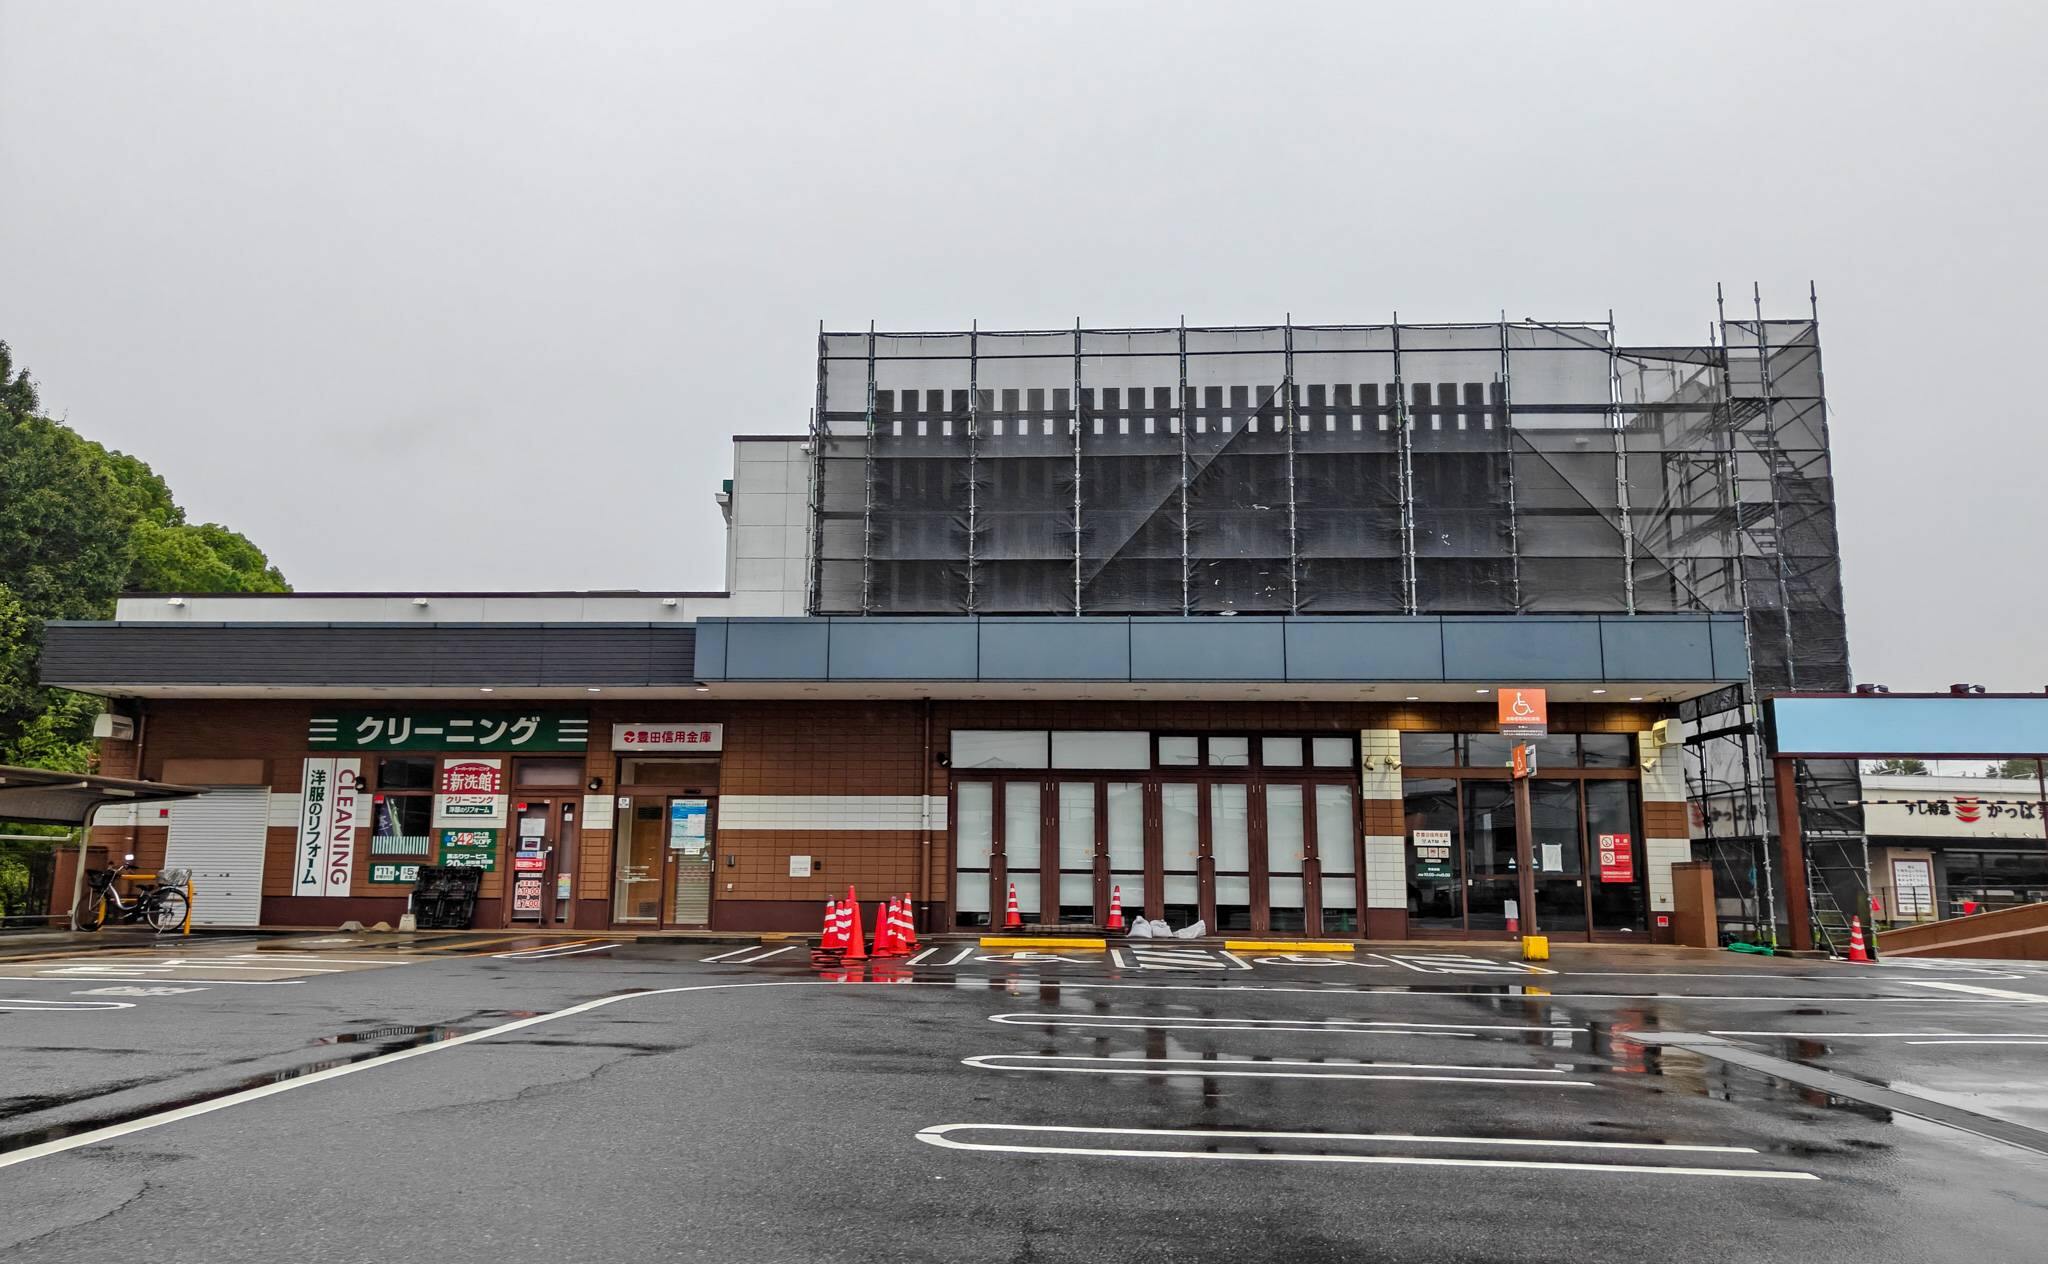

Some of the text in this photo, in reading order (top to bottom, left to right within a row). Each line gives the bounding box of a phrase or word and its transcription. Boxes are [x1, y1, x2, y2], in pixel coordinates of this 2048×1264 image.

[355, 715, 541, 745] クリーニング
[636, 730, 712, 744] 豊田信用金庫
[449, 771, 493, 792] 新洗館
[446, 796, 494, 804] クリーニング
[301, 768, 327, 886] 洋服のリフォーム
[330, 768, 357, 886] CLEANING
